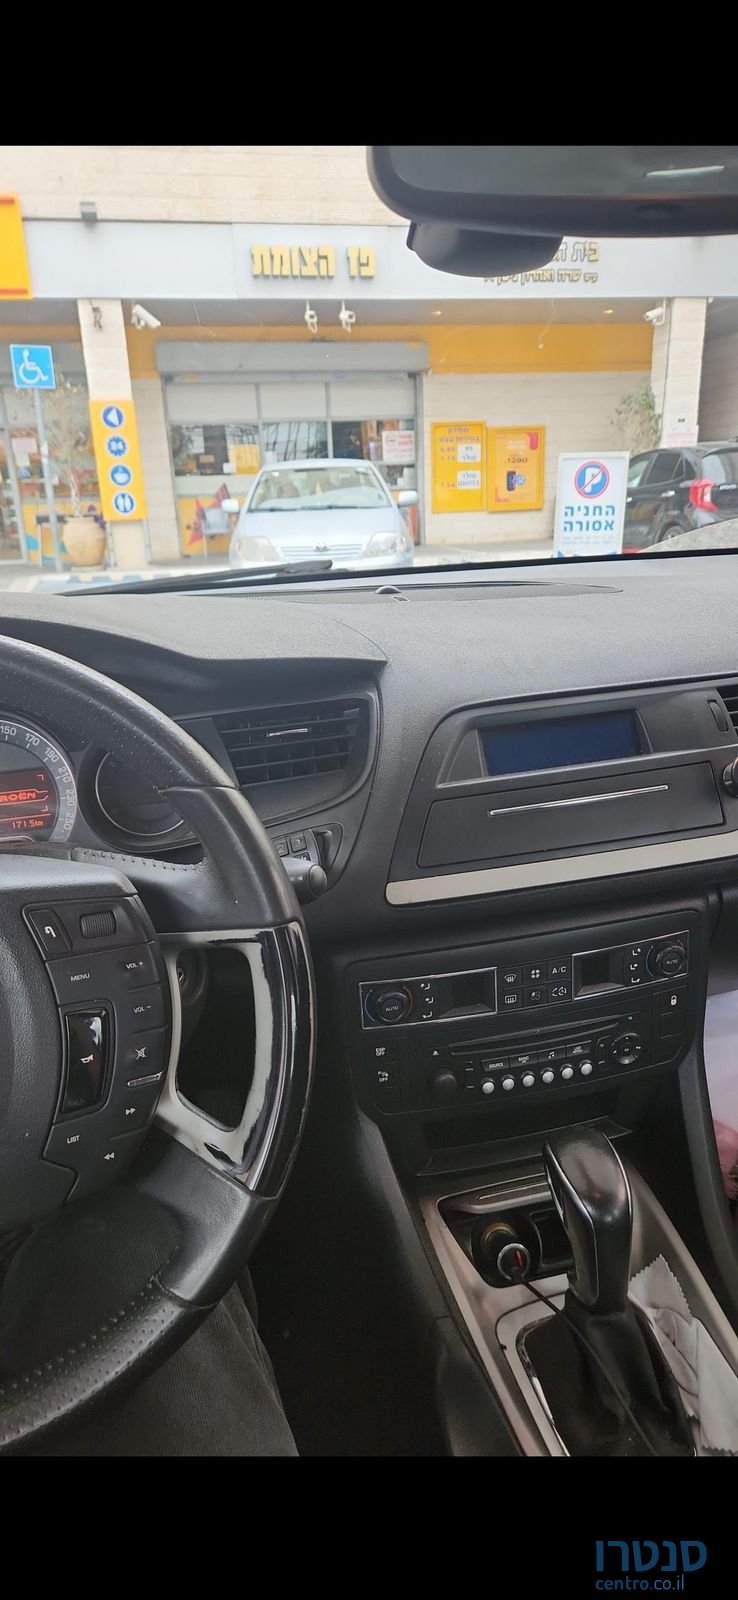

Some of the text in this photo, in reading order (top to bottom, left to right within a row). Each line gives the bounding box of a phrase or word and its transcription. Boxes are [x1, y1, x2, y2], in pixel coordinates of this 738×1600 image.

[251, 244, 376, 278] פז הצומת
[564, 505, 615, 517] החניה
[563, 520, 614, 532] אסורה
[0, 725, 17, 736] 150
[25, 733, 40, 746] 170
[44, 747, 60, 763] 190
[58, 766, 72, 784] 210
[65, 789, 75, 806] 230
[552, 966, 567, 974] A/C
[70, 973, 90, 982] MENU
[67, 1134, 80, 1144] LIST
